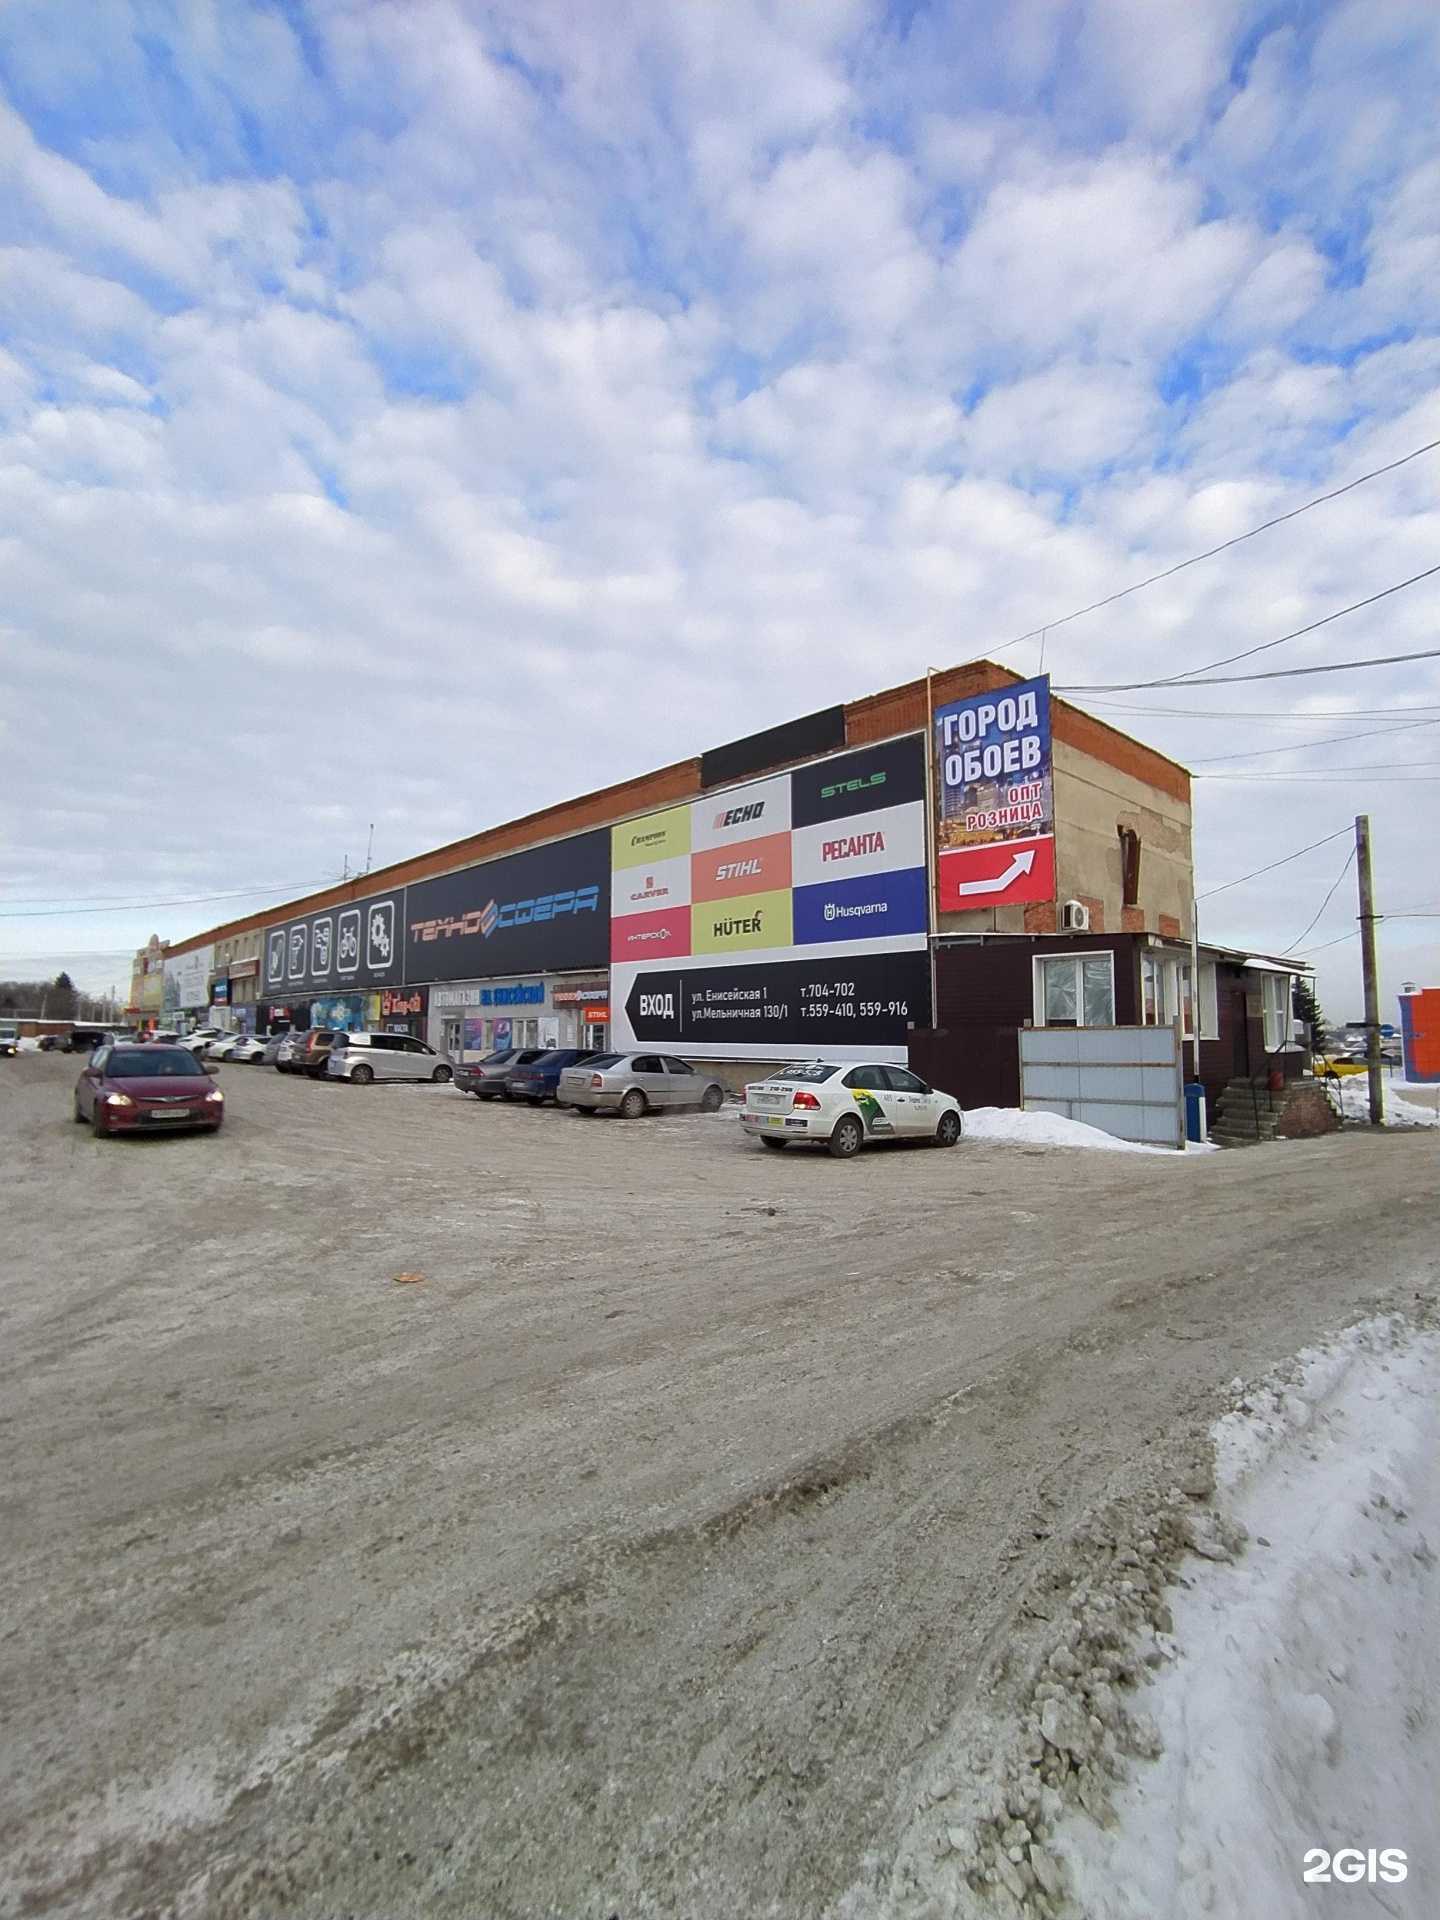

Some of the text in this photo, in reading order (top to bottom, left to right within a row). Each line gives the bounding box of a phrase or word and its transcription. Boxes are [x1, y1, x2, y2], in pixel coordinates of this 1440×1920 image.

[943, 691, 1038, 746] ГОРОД
[945, 735, 1042, 786] ОБОЕВ
[820, 771, 887, 798] STELS
[1009, 782, 1042, 804] ОПТ
[723, 801, 765, 827] ECHO
[966, 802, 1044, 831] РОЗНИЦА
[822, 832, 885, 862] РЕСАНТА
[715, 858, 763, 881] STIHL
[630, 887, 669, 900] CARVER
[836, 902, 888, 918] Husqvarna
[713, 910, 763, 937] HÜTER
[691, 987, 767, 1004] ул. Енисейская 1
[800, 982, 855, 998] т.704-702
[640, 993, 675, 1019] ВХОД
[763, 1004, 788, 1019] 130/1
[800, 1001, 908, 1018] т.559-410, 559-916
